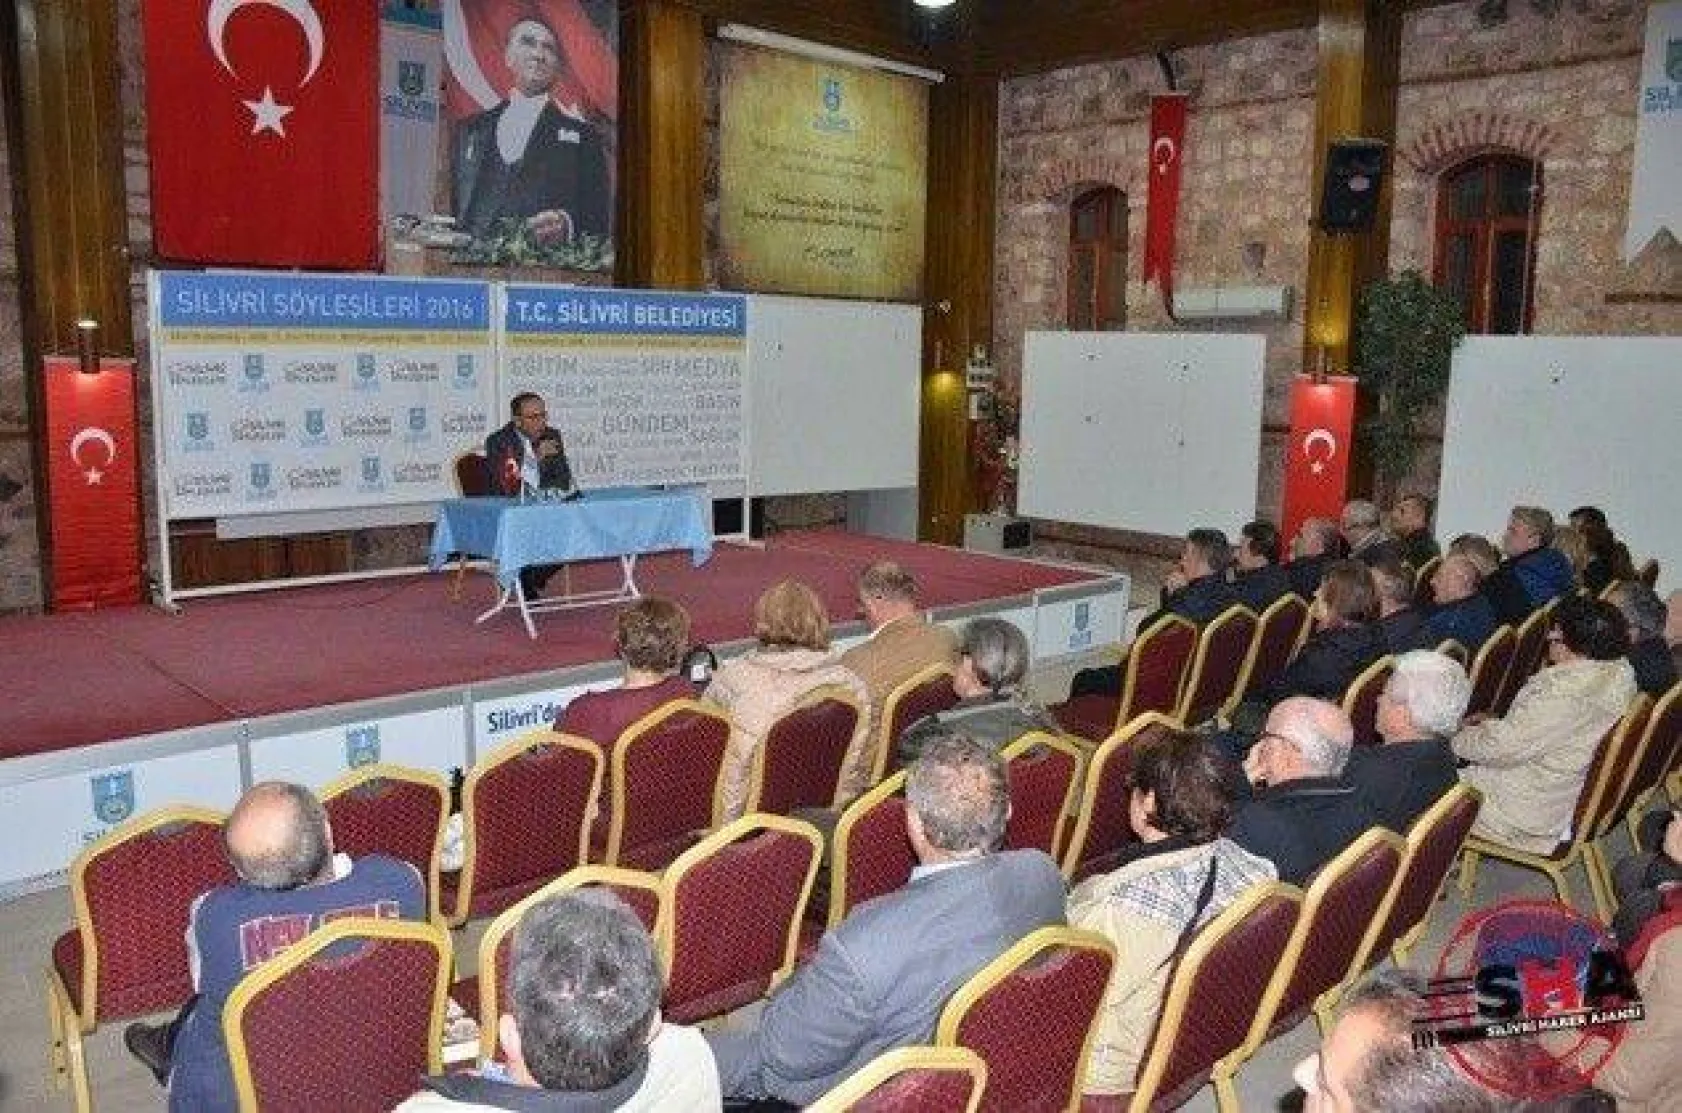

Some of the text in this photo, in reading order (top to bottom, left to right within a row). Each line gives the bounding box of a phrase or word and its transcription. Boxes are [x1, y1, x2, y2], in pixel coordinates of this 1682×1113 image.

[515, 299, 738, 328] T.C. SİLİVRİ BELEDİYESİ
[601, 411, 690, 436] GÜNDEM
